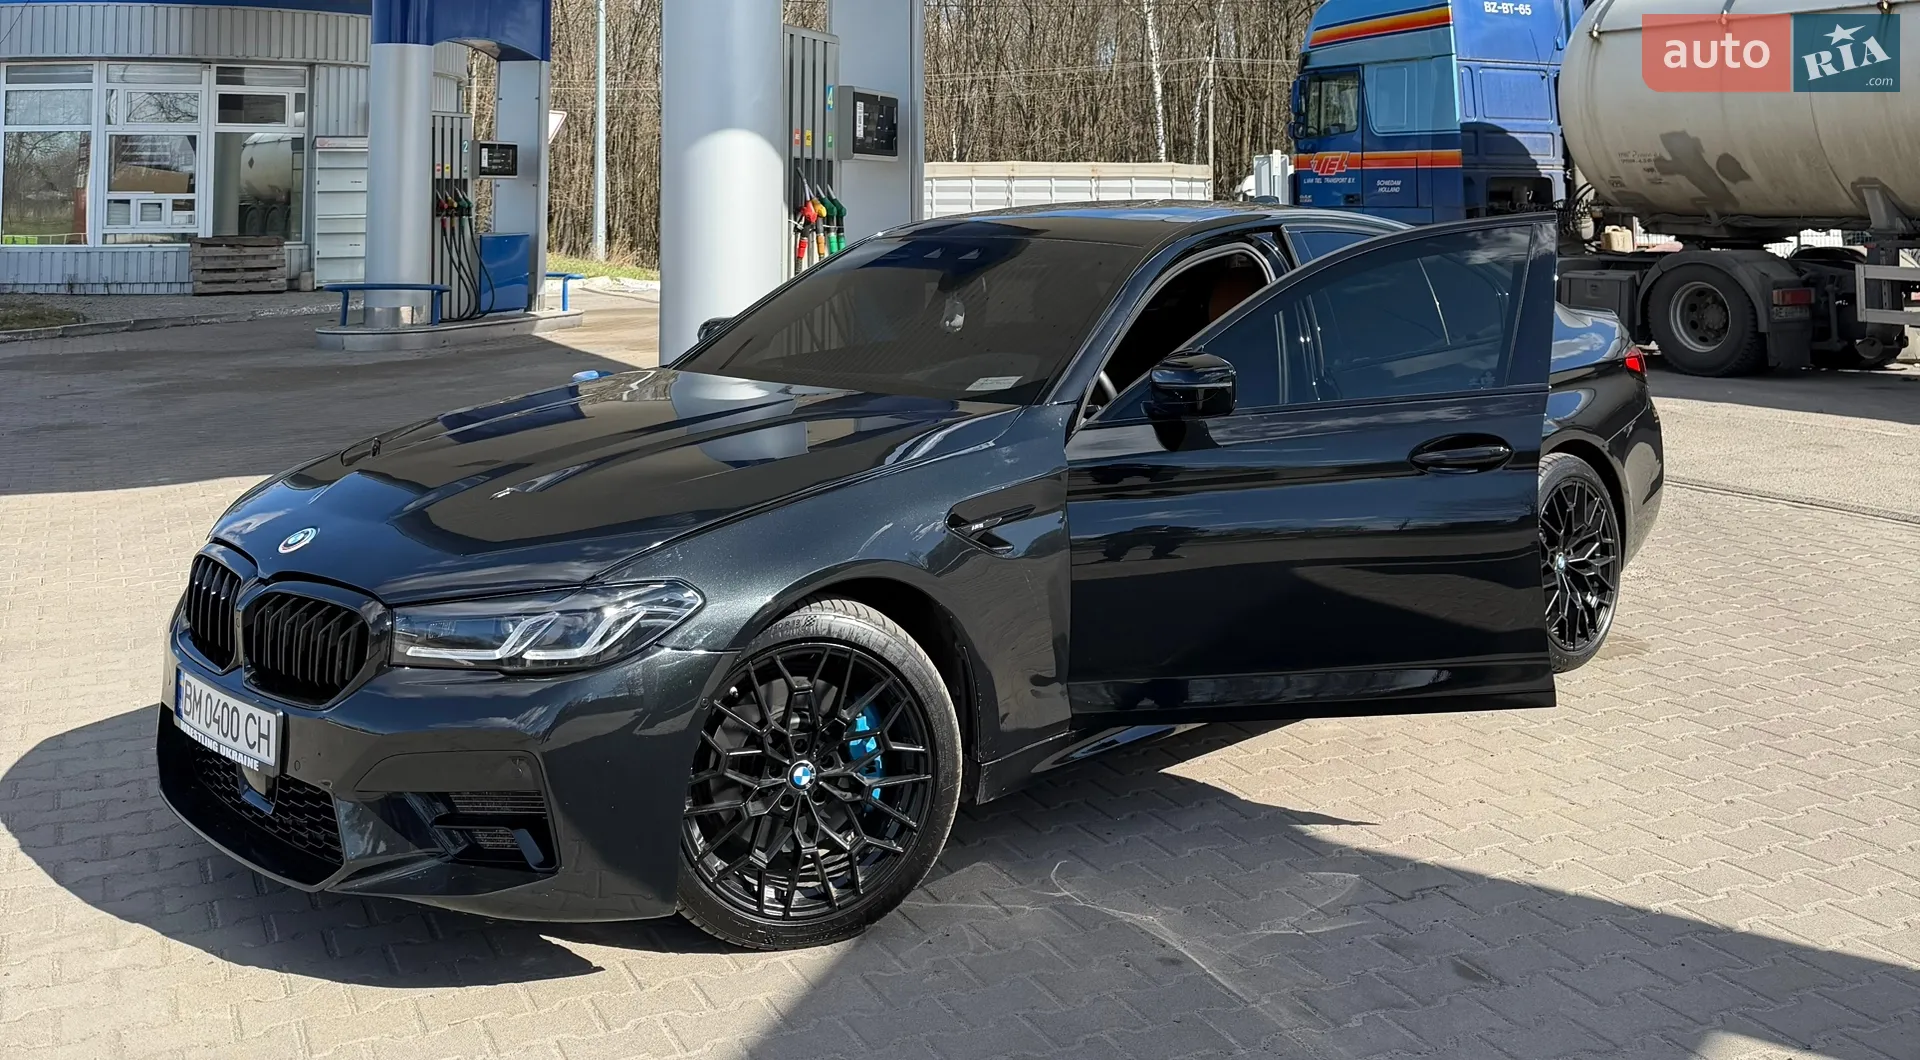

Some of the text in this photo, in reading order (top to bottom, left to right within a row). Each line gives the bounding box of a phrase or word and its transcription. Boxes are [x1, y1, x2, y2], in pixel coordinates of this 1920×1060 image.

[1484, 1, 1532, 16] BZ-BT-65
[462, 140, 469, 153] 2
[183, 679, 271, 758] BM 0400 CH
[220, 744, 260, 773] UKRAINE
